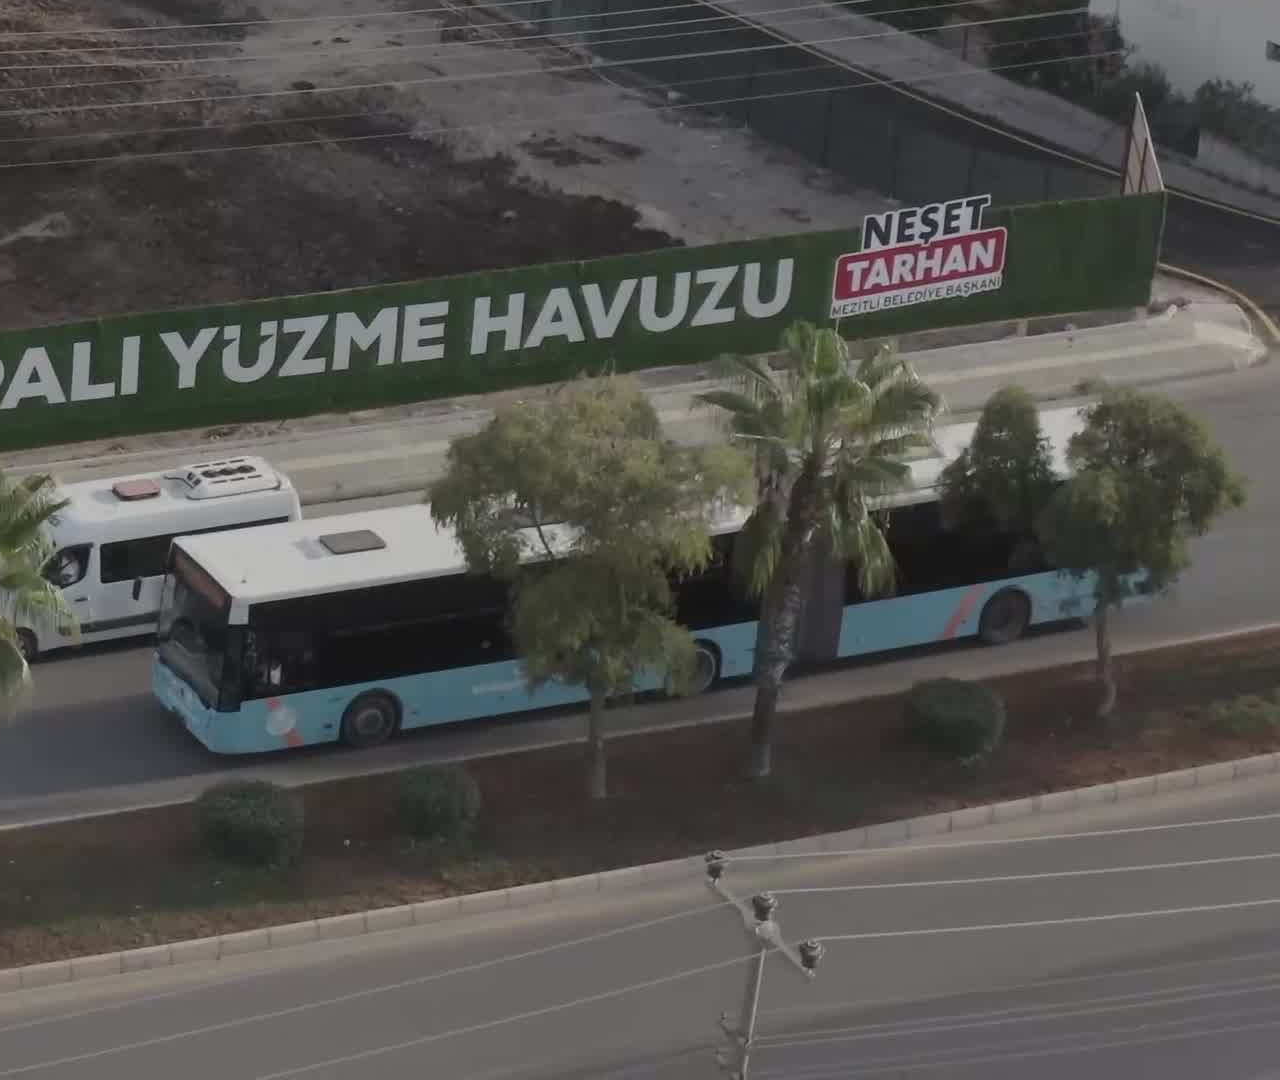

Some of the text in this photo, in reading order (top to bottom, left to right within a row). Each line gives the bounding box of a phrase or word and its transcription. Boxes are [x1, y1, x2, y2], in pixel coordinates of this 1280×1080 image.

[863, 197, 990, 250] NEŞET
[847, 238, 997, 292] TARHAN
[883, 286, 942, 307] BELEDİYE
[159, 301, 449, 390] YÜZME
[470, 258, 794, 355] HAVUZU
